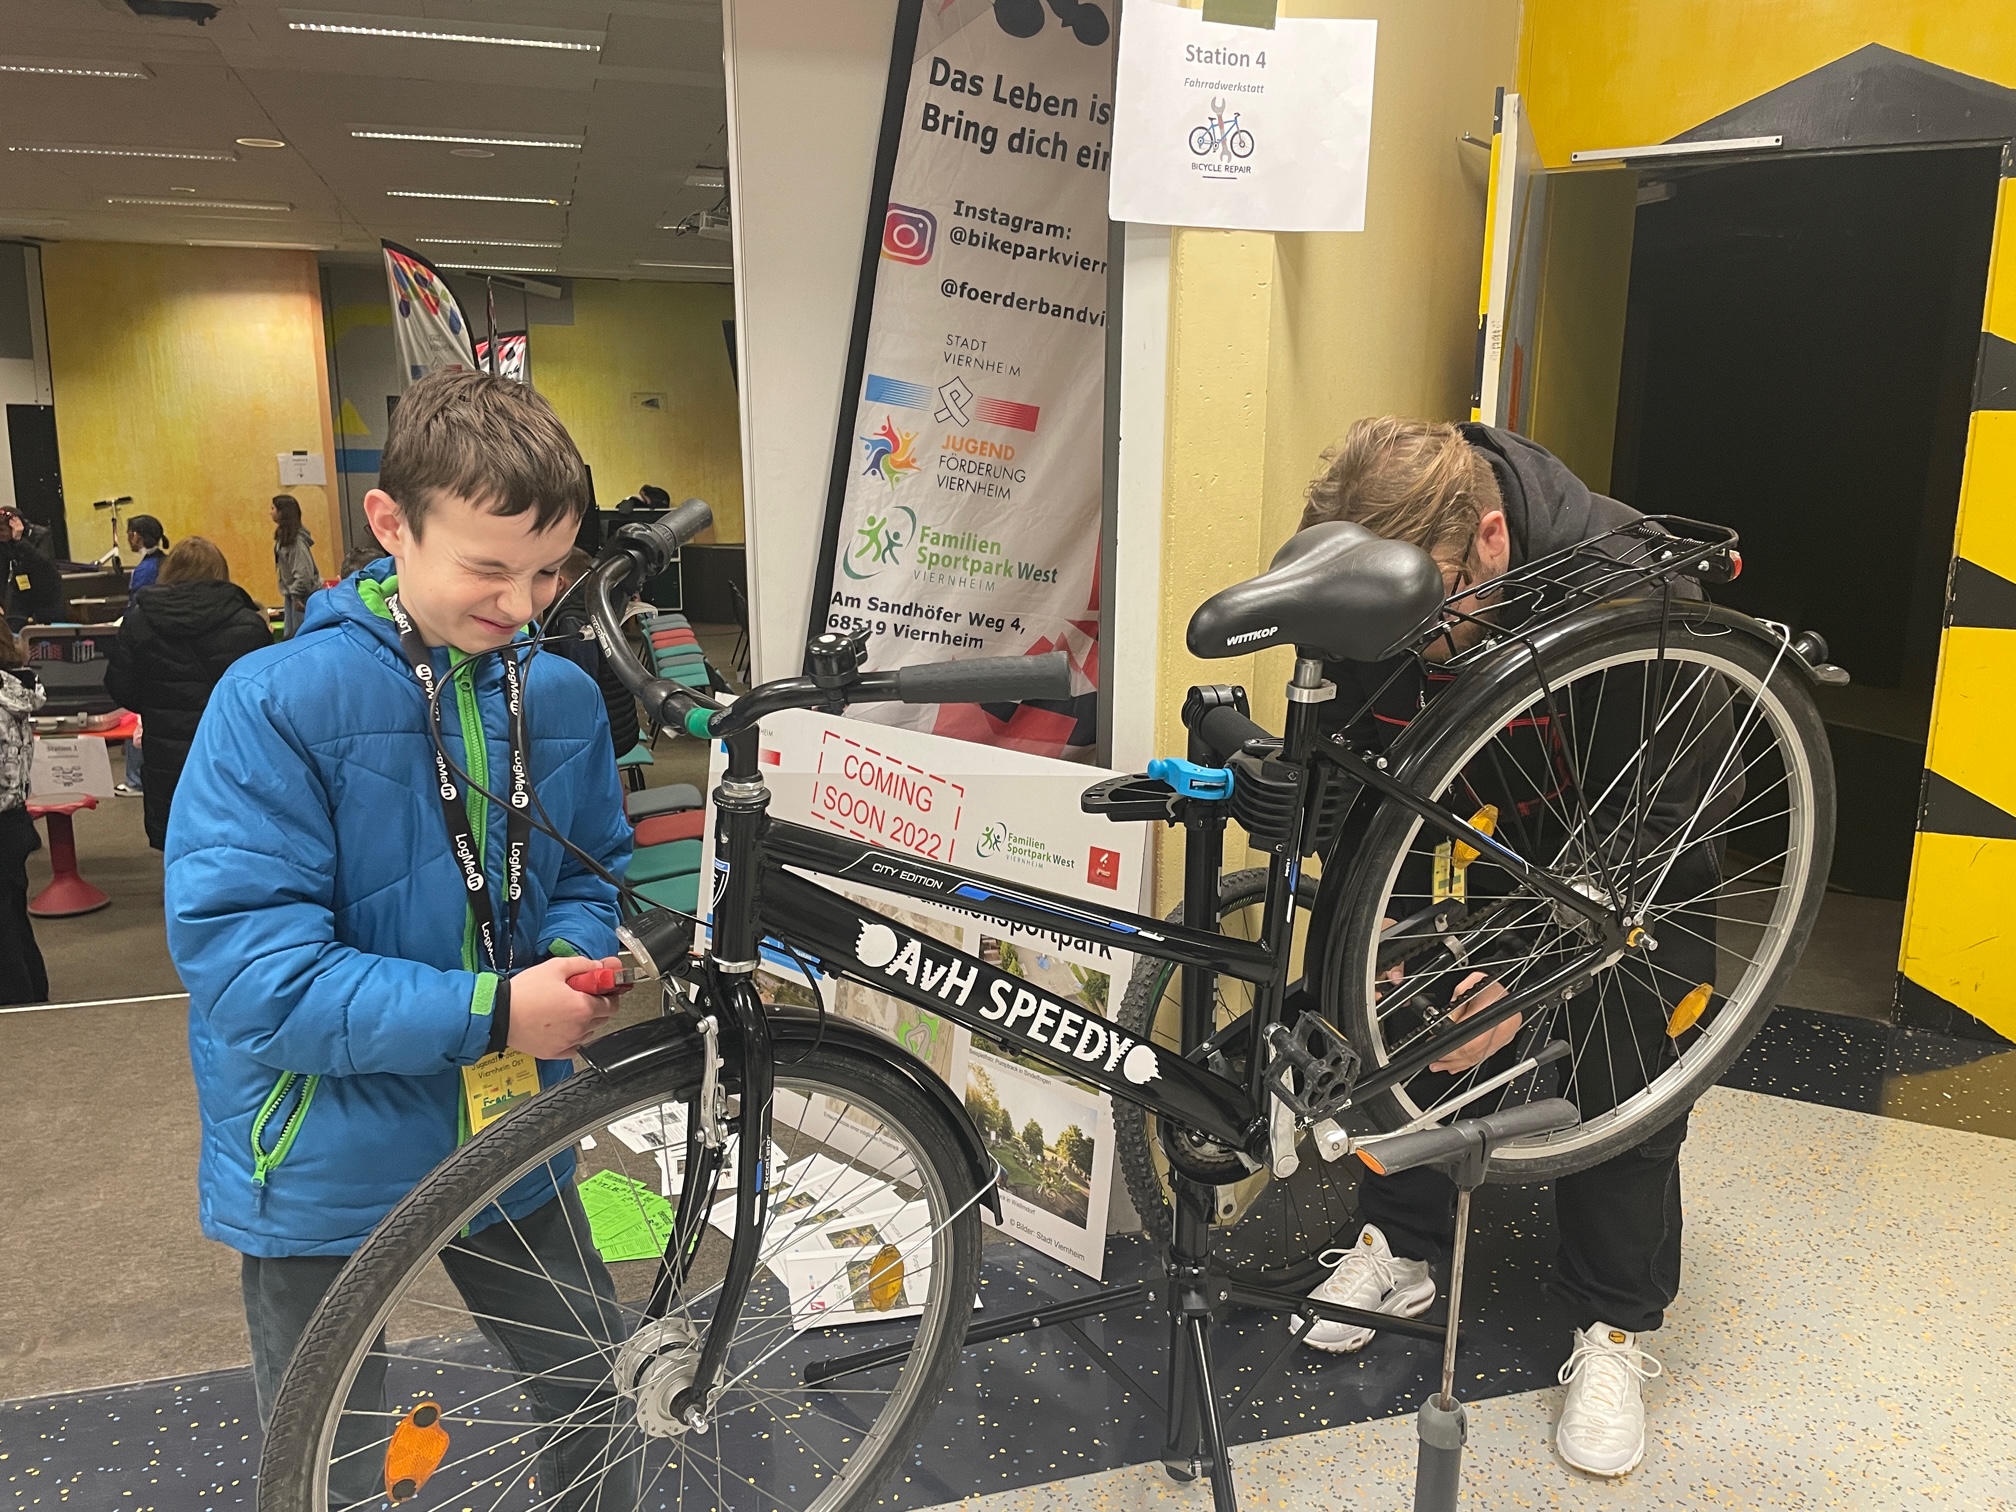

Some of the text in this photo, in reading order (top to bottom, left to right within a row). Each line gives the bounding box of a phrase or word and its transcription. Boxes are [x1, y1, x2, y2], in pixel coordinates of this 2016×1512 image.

[1185, 44, 1266, 69] Station 4
[929, 56, 984, 96] Das
[993, 74, 1078, 118] Leben
[1184, 77, 1264, 93] Fahrradwerkstatt
[921, 102, 998, 154] Bring
[1007, 127, 1068, 162] dich
[1191, 162, 1252, 174] BICYCLE REPAIR
[953, 199, 1072, 240] Instagram:
[946, 334, 987, 352] STADT
[943, 351, 1021, 377] VIERNHEIM
[941, 434, 1015, 461] JUGEND
[938, 452, 1026, 483] FÖRDERUNG
[936, 474, 1011, 500] VIERNHEIM
[919, 525, 1001, 556] Familien
[916, 545, 1058, 584] Sportpark West
[913, 569, 995, 593] VIERNHEIM
[831, 591, 1026, 635] Am Sandhöfer Weg 4,
[893, 623, 983, 649] Viernheim
[1226, 626, 1278, 646] WITTKOP
[844, 755, 933, 812] COMING
[823, 785, 942, 860] SOON 2022
[1007, 832, 1045, 850] Familien
[455, 833, 485, 892] LogMeIn
[1006, 843, 1075, 869] Sportpark West
[1006, 854, 1044, 869] VIERNHEIM
[508, 842, 525, 901] LogMeIn
[871, 862, 944, 890] CITY EDITION
[885, 938, 1135, 1073] AvH SPEEDY
[512, 1058, 524, 1068] Ost
[995, 1058, 1018, 1073] Pumptrack
[1023, 1070, 1052, 1085] Sindelfingen
[763, 1134, 771, 1191] Excelsior
[1016, 1221, 1036, 1237] Bilder:
[1036, 1231, 1053, 1245] Stadt
[1053, 1240, 1085, 1261] Viernheim
